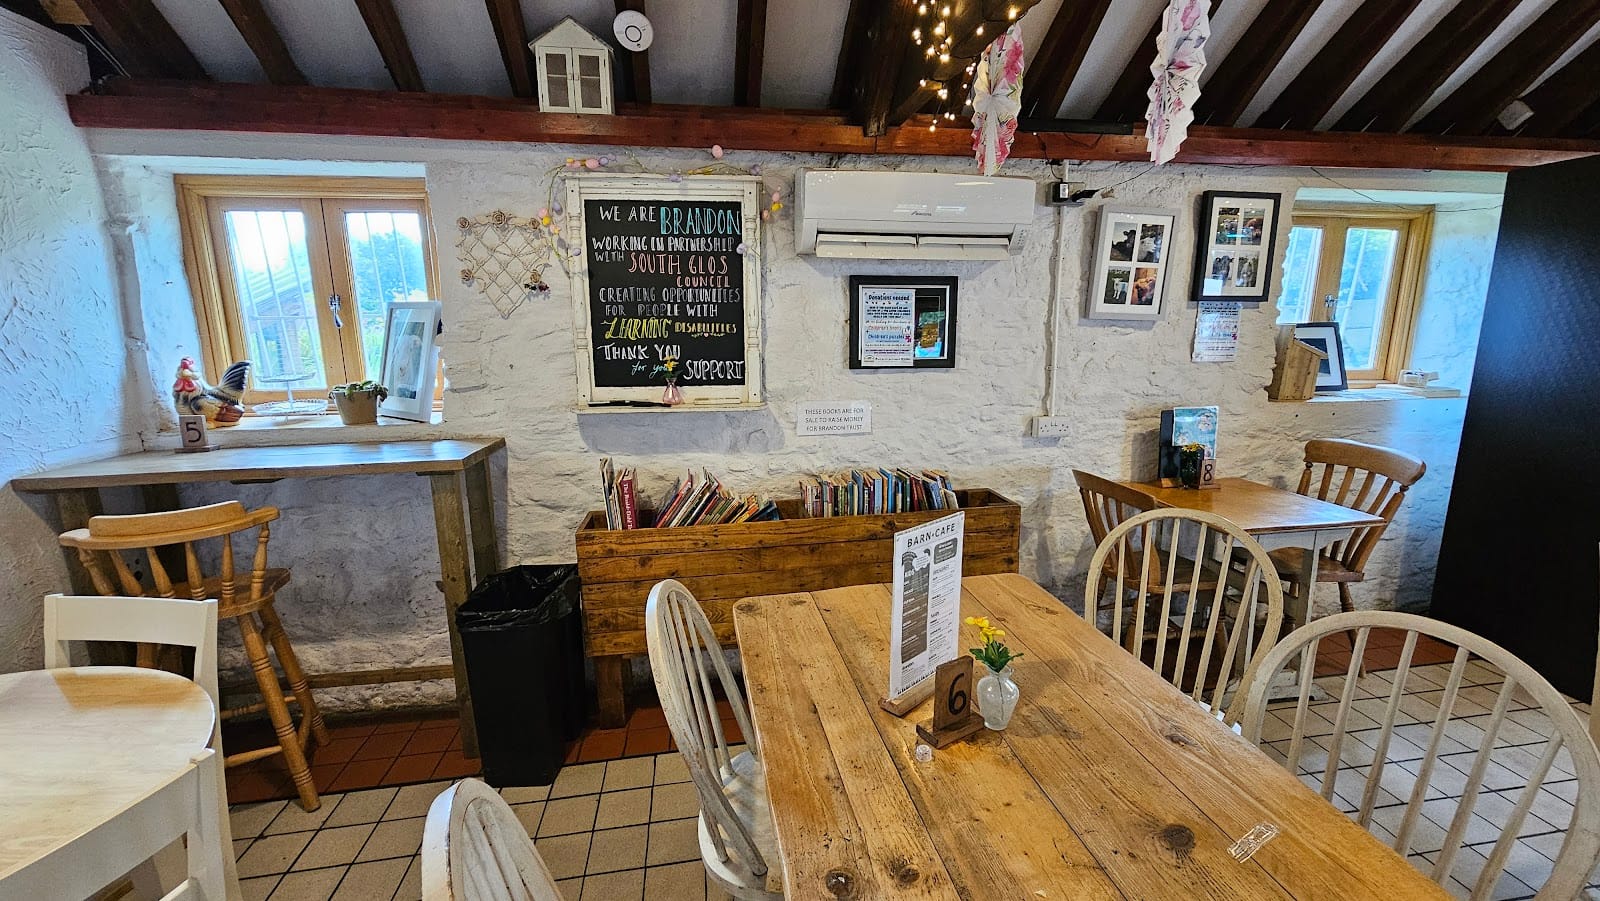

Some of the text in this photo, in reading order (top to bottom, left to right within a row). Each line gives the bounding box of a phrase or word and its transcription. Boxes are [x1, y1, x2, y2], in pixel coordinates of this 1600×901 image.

[600, 206, 741, 235] WE ARE BRANDON
[592, 236, 735, 252] WORKING IN PARTNERSHIP
[595, 251, 729, 275] WITH SOUTH GLOS
[676, 276, 731, 288] COUNCIL
[599, 287, 741, 303] CREATING OPPORTUNITIES
[605, 303, 719, 317] FOR PEOPLE WITH
[600, 316, 737, 341] LEARNING DISABILITIES
[597, 343, 682, 361] THANK YOU
[631, 360, 647, 376] for
[682, 358, 745, 381] SUPPORT
[186, 421, 202, 443] 5
[1203, 463, 1213, 482] 8
[948, 672, 967, 716] 6
